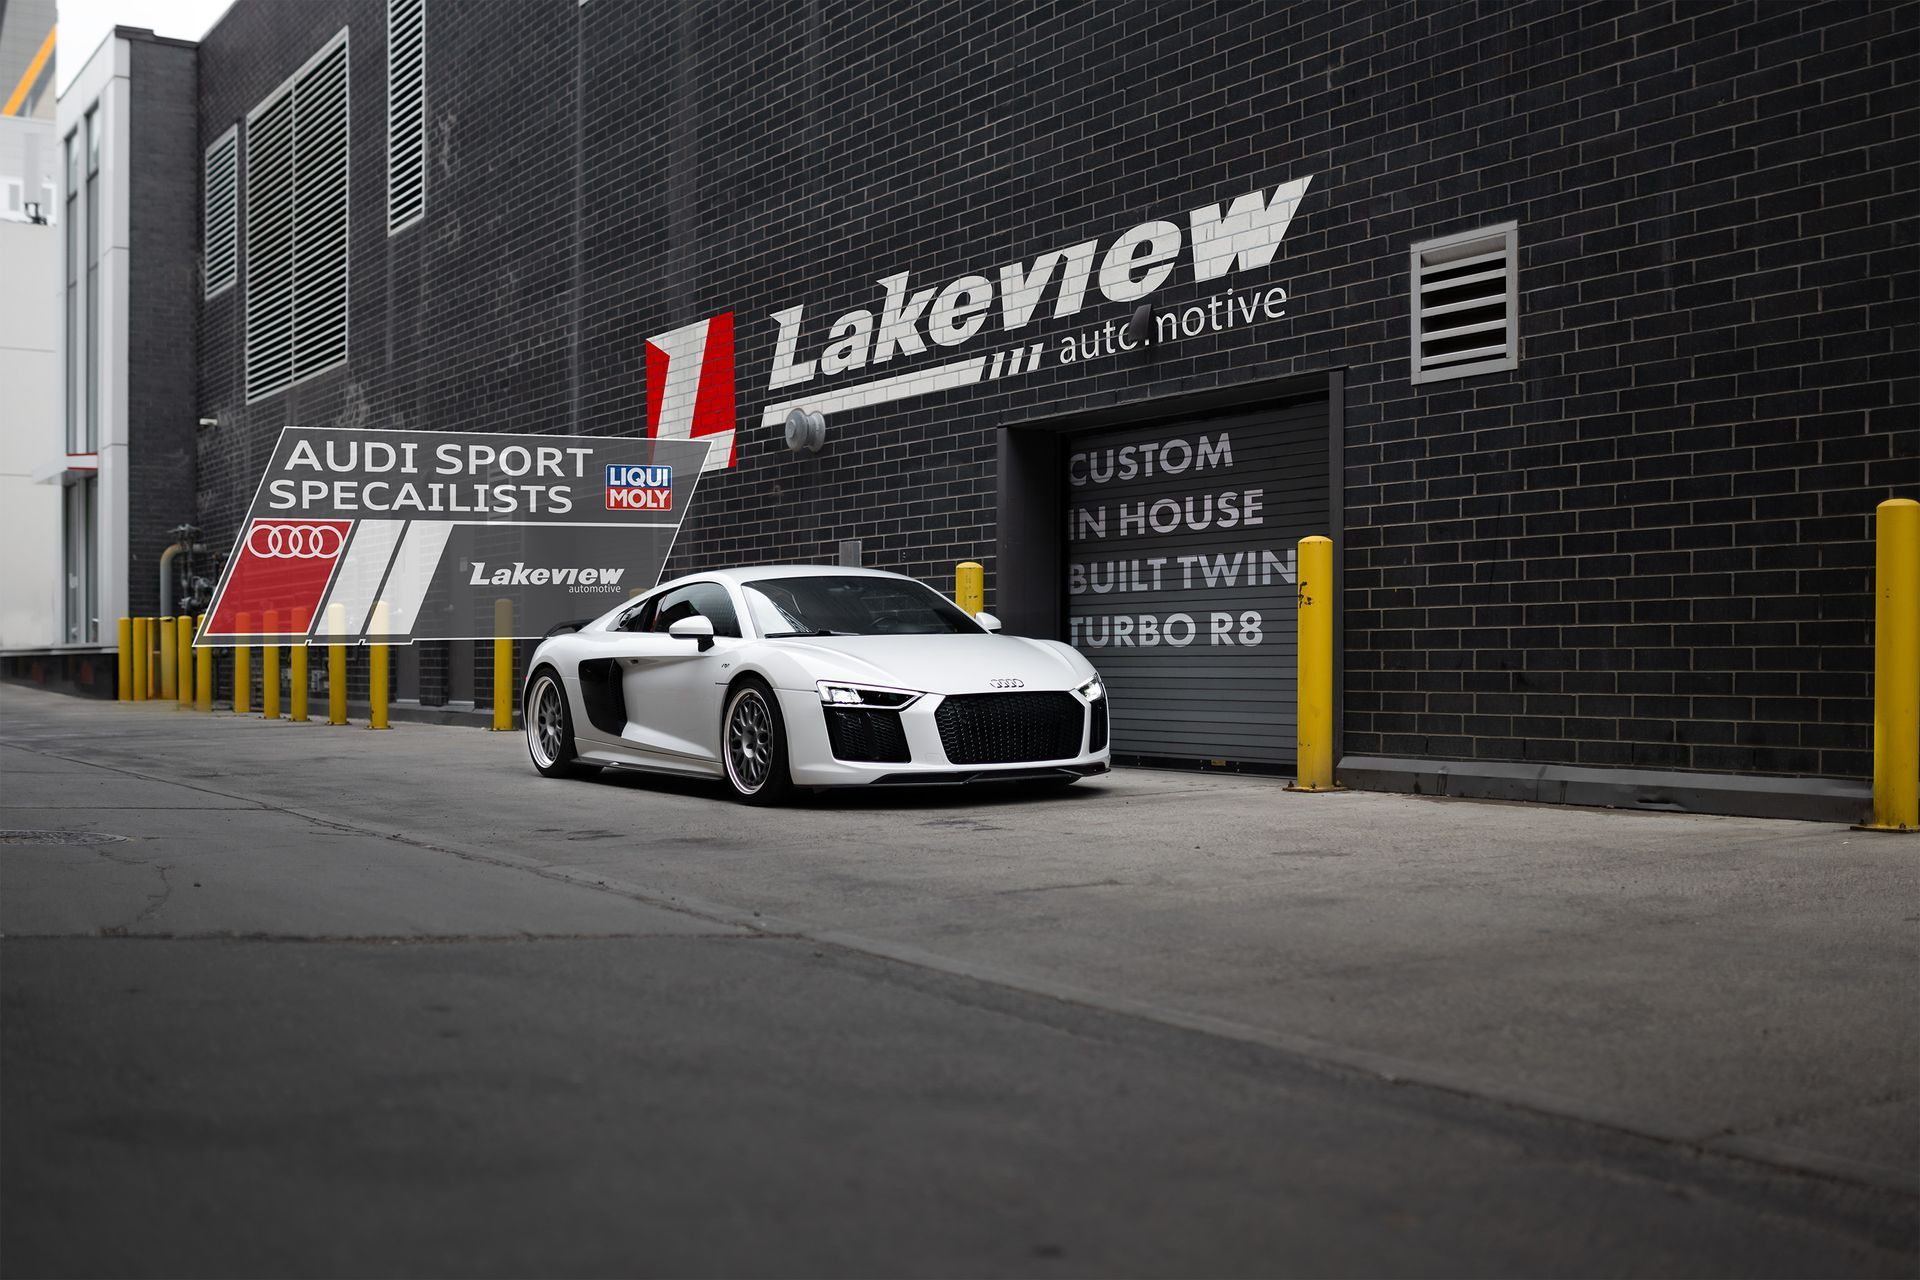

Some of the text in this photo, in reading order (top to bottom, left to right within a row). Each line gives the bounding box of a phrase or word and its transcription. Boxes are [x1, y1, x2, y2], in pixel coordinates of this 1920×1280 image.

[768, 175, 1313, 390] Lakeview
[1070, 433, 1234, 486] CUSTOM
[1119, 489, 1264, 536] HOUSE
[1070, 548, 1297, 594] BUILT TWIN
[1070, 610, 1263, 648] TURBO R8
